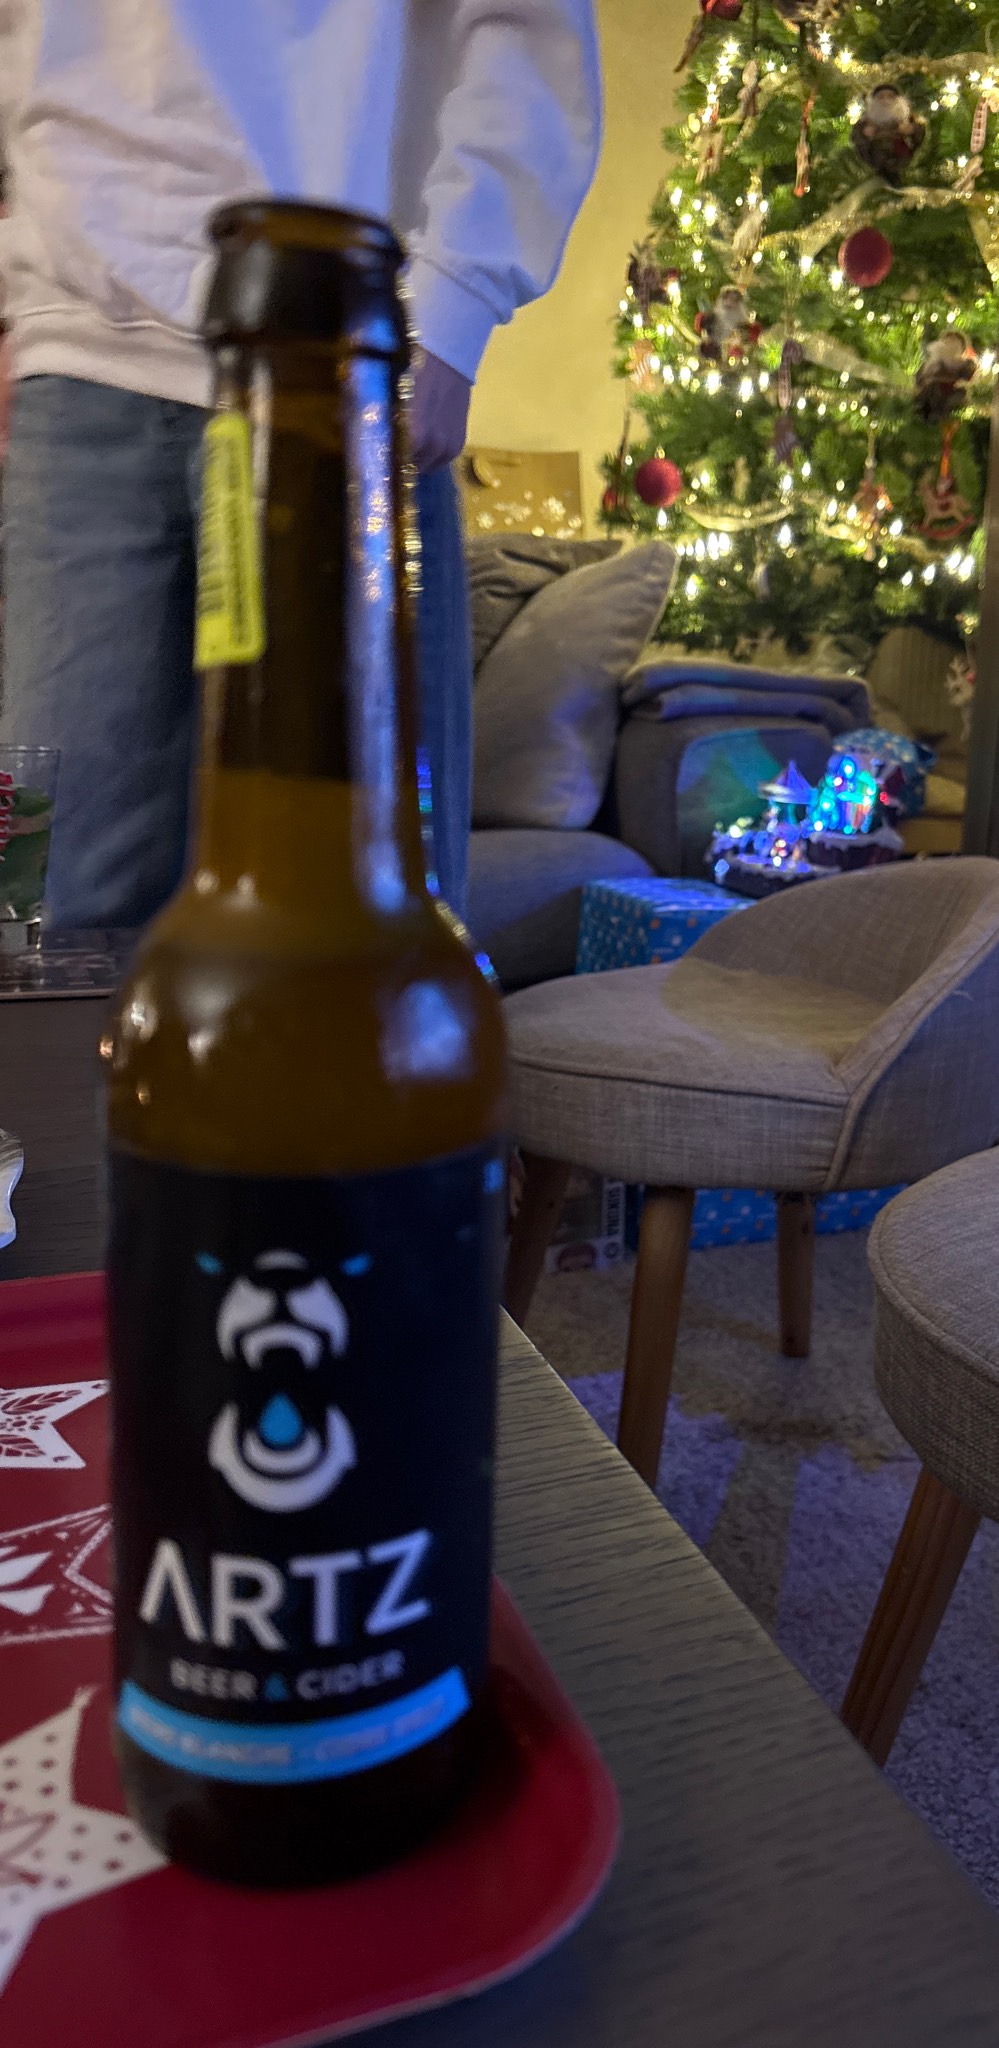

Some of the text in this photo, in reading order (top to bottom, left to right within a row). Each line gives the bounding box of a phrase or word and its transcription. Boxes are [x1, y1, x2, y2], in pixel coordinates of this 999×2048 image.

[138, 1528, 432, 1649] ARTZ
[169, 1657, 258, 1699] BEER
[297, 1649, 404, 1699] CIDER
